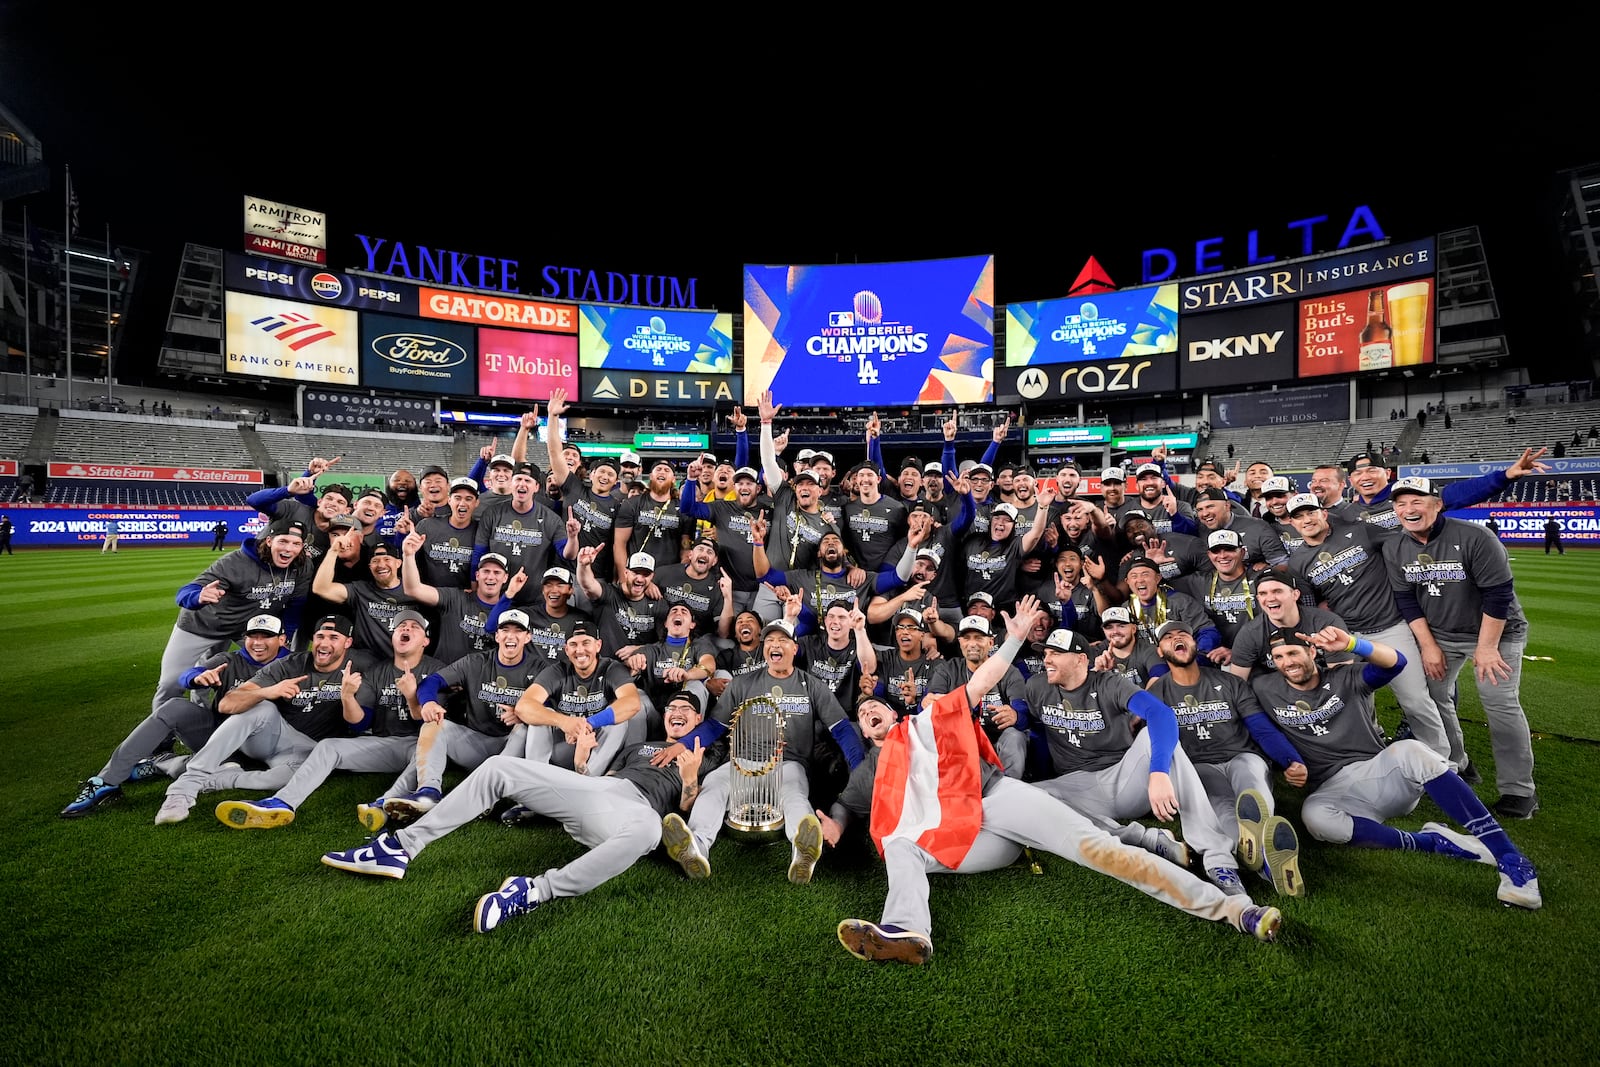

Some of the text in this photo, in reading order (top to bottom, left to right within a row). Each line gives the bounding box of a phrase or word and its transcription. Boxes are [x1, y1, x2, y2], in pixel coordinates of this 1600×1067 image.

[248, 203, 322, 226] ARMITRON
[252, 237, 318, 256] ARMITRON
[1142, 204, 1386, 283] DELTA
[245, 267, 293, 286] PEPSI
[354, 233, 699, 309] YANKEE STADIUM
[312, 280, 341, 293] PEPSI
[1183, 250, 1429, 310] STARR INSURANCE
[358, 286, 401, 303] PEPSI
[429, 294, 571, 328] GATORADE
[1304, 300, 1346, 315] This
[1060, 322, 1088, 330] WORLD
[1305, 313, 1355, 330] Bud's
[821, 325, 913, 337] WORLD SERIES
[1051, 322, 1127, 341] CHAMPIONS
[1305, 332, 1334, 345] For
[389, 335, 450, 364] Ford
[624, 337, 691, 352] CHAMPIONS
[806, 333, 928, 355] CHAMPIONS
[1188, 331, 1284, 362] DKNY
[1304, 346, 1344, 359] You.
[230, 353, 356, 375] BANK OF AMERICA
[389, 366, 451, 378] BuyFordNow.com
[485, 353, 572, 377] T Mobile
[857, 354, 879, 384] LA
[1060, 361, 1151, 394] razr
[629, 378, 733, 400] DELTA
[1292, 413, 1317, 421] BOSS
[88, 467, 154, 478] State Farm
[192, 470, 249, 481] State Farm
[30, 521, 65, 532] 2024
[117, 521, 157, 532] SERIES
[495, 526, 543, 538] WORLD SERIES
[431, 544, 457, 554] WORLD
[1308, 545, 1364, 577] WORLD SERIES
[1429, 562, 1464, 571] SERIES
[532, 628, 557, 638] WORLD
[1042, 705, 1103, 721] WORLD SERIES
[1173, 701, 1230, 716] ORLD SERIES
